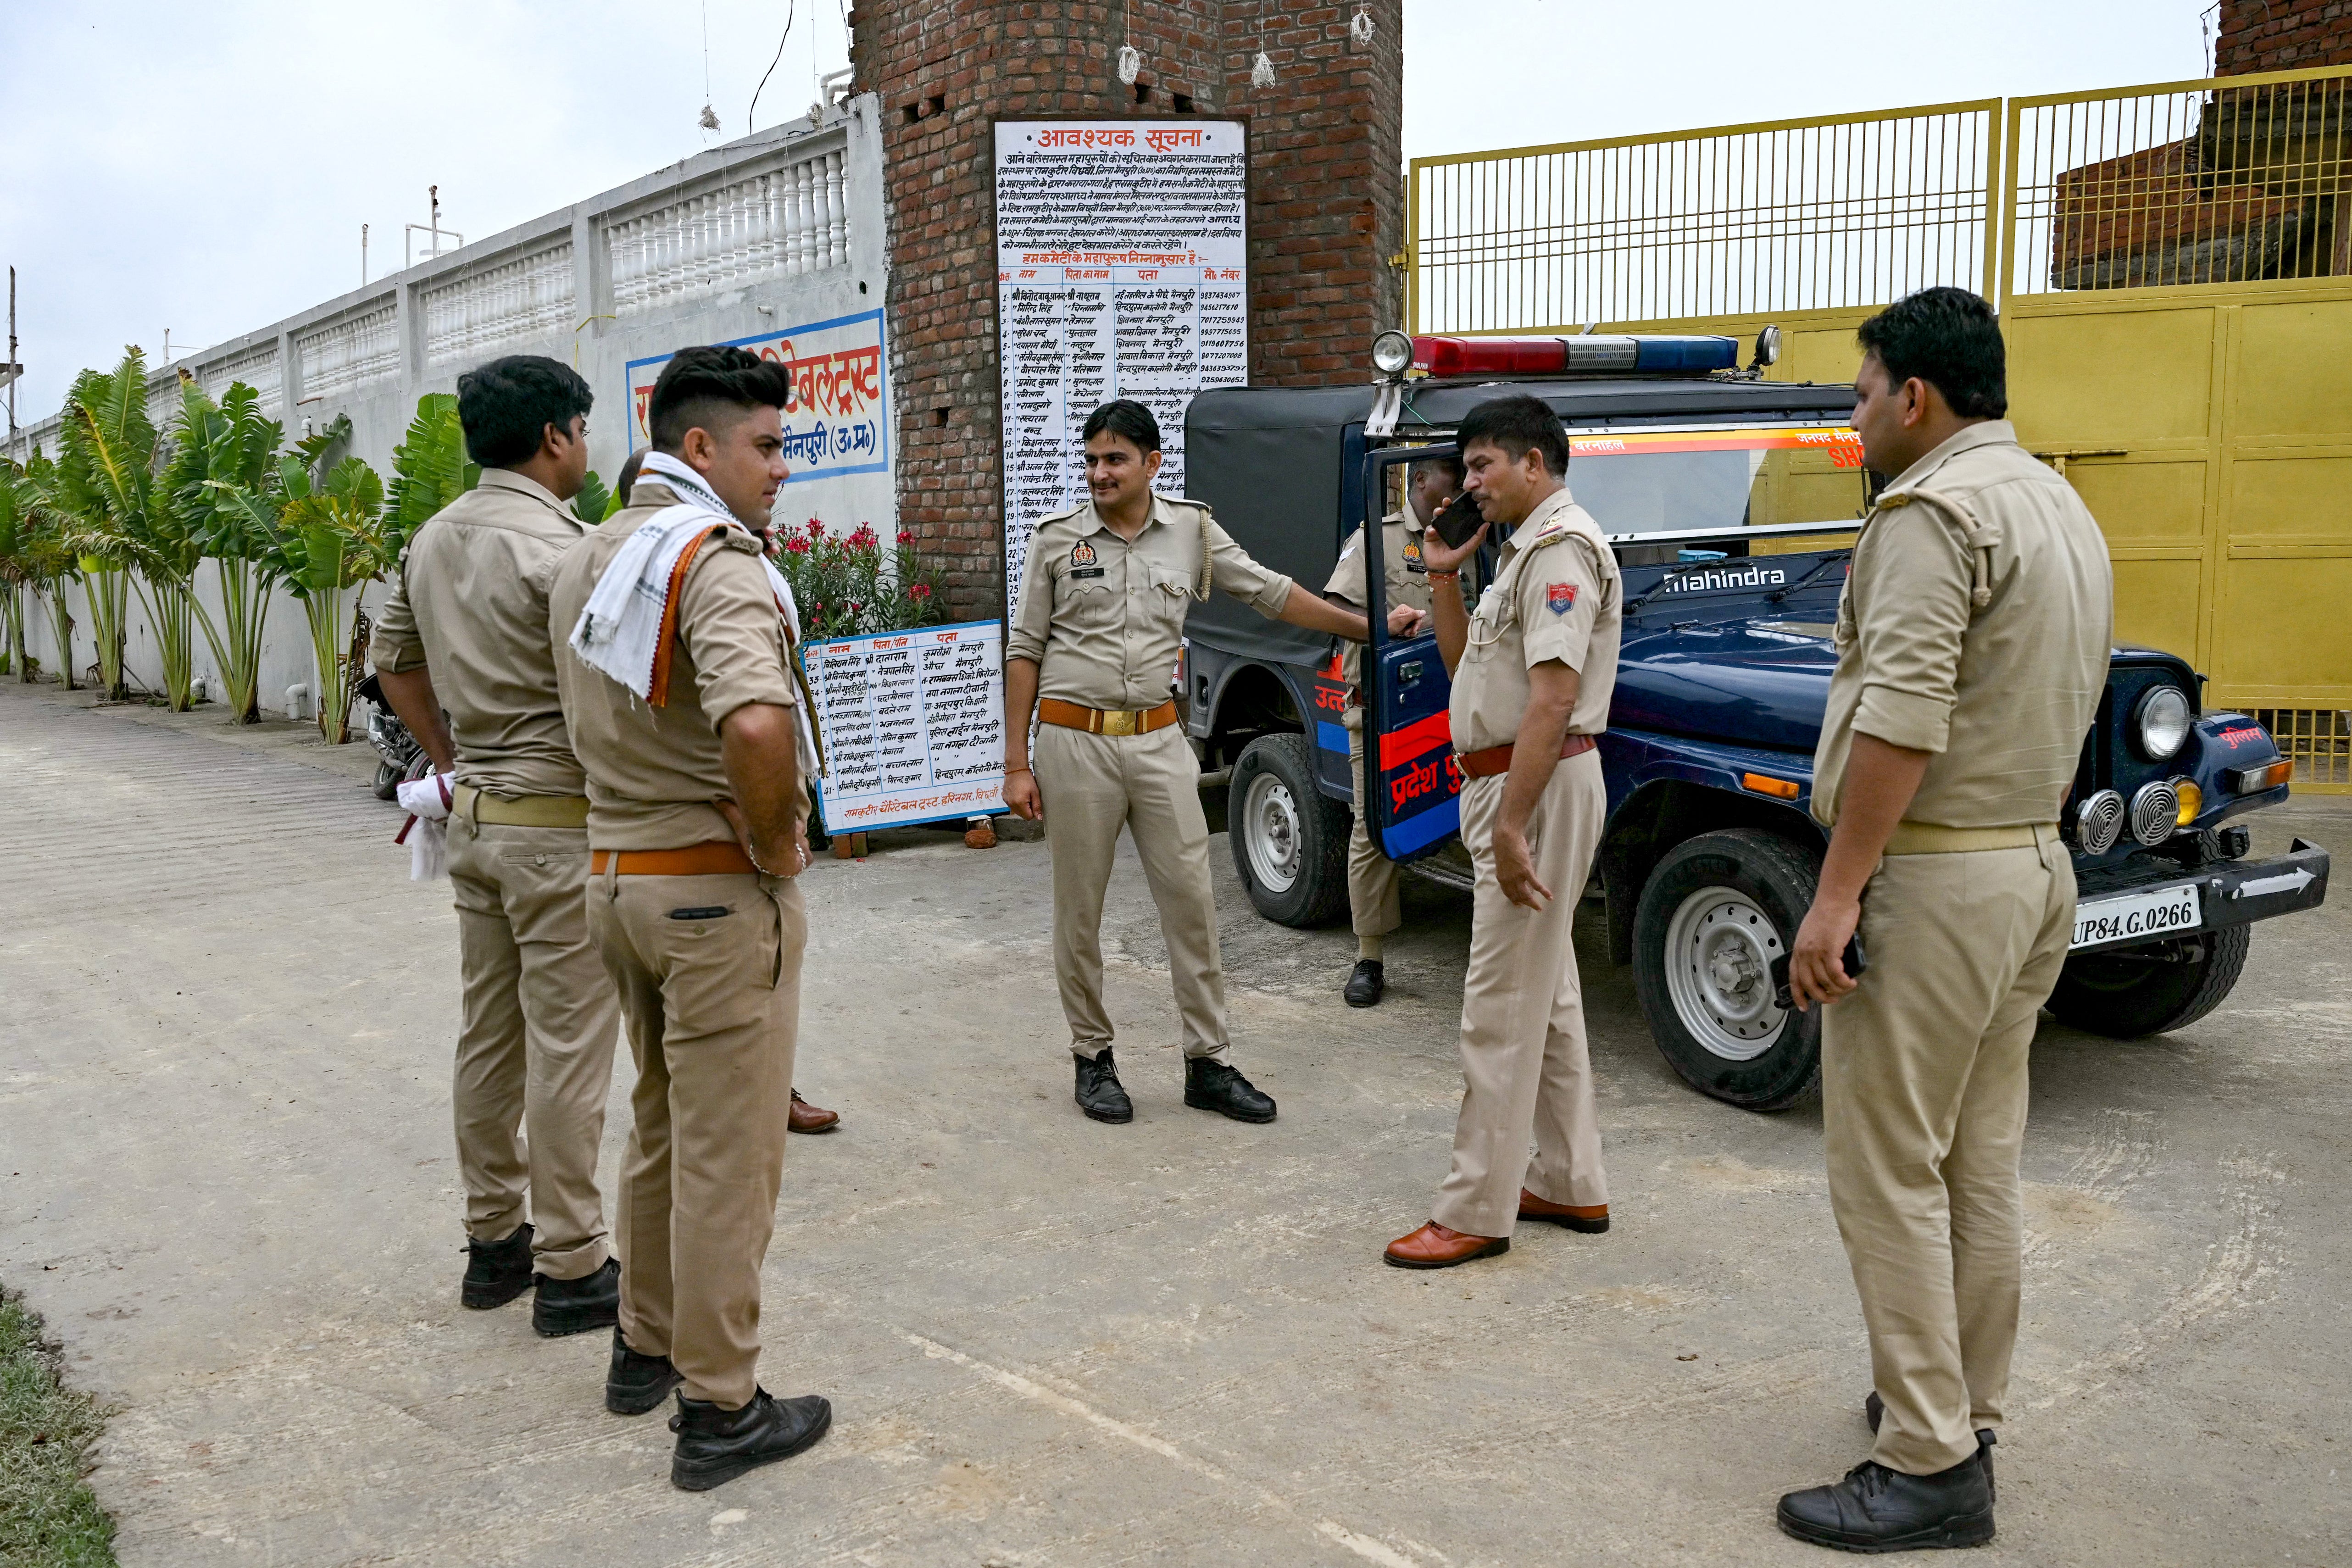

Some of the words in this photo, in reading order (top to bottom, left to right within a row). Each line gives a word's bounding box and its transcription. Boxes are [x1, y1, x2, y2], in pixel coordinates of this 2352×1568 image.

[1037, 129, 1135, 149] आवश्यक
[1145, 129, 1203, 152] सूचना
[1005, 151, 1025, 164] आने
[1026, 151, 1042, 164] वाले
[1042, 154, 1068, 164] समस्त
[1109, 151, 1122, 163] को
[1122, 152, 1146, 164] सूचित
[1146, 155, 1159, 164] कर
[1158, 155, 1186, 164] अवगत
[1185, 155, 1211, 164] कराया
[1211, 155, 1230, 164] जाता
[1230, 153, 1236, 165] है
[999, 217, 1010, 225] हम
[1010, 217, 1032, 225] समस्त
[1032, 214, 1053, 224] कमेटी
[1052, 214, 1060, 223] के
[1161, 214, 1169, 223] के
[1186, 214, 1206, 224] अपने
[1207, 216, 1241, 224] आराध्य
[1001, 240, 1013, 250] को
[1141, 239, 1163, 250] करते
[1023, 253, 1040, 264] हम
[1039, 250, 1072, 264] कमेटी
[1072, 250, 1083, 264] के
[1127, 250, 1186, 267] निम्नानुसार
[1187, 250, 1196, 266] है
[1018, 269, 1038, 278] नाम
[1065, 267, 1082, 280] पिता
[1083, 270, 1094, 279] का
[1094, 270, 1110, 279] नाम
[1137, 270, 1159, 281] पता
[1220, 267, 1241, 281] नंबर
[1012, 287, 1021, 301] श्री
[1076, 292, 1101, 302] नाथूराम
[1114, 289, 1126, 300] नई
[1124, 289, 1147, 300] तहसील
[1147, 289, 1154, 299] के
[1155, 288, 1170, 300] पीछे
[1171, 288, 1195, 300] मैनपुरी
[1039, 302, 1053, 314] सिंह
[1142, 301, 1168, 312] कालोनी
[1169, 301, 1193, 313] मैनपुरी
[1068, 314, 1096, 325] तेजराम
[1145, 314, 1175, 325] मैनपुरी
[1017, 328, 1033, 339] सुरेश
[1134, 326, 1158, 337] विकास
[1162, 325, 1192, 337] मैनपुरी
[1152, 337, 1184, 350] मैनपुरी
[1116, 352, 1140, 361] आवास
[1139, 349, 1166, 361] विकास
[1168, 349, 1194, 361] मैनपुरी
[1020, 363, 1048, 374] वीरपाल
[1047, 363, 1062, 374] सिंह
[1147, 363, 1173, 373] कालोनी
[1174, 362, 1198, 374] मैनपुरी
[1017, 376, 1038, 387] प्रमोद
[1038, 378, 1059, 389] कुमार
[1021, 398, 1052, 412] रामदुलारे
[782, 420, 828, 466] मैनपुरी
[1795, 433, 1832, 444] जनपद
[1573, 439, 1626, 452] बरनाहल
[1043, 461, 1060, 472] सिंह
[1042, 473, 1060, 484] सिंह
[1050, 484, 1066, 496] सिंह
[1042, 497, 1059, 508] सिंह
[828, 645, 851, 654] नाम
[937, 632, 959, 643] पता
[865, 654, 873, 665] श्री
[958, 641, 985, 654] मैनपुरी
[824, 671, 832, 682] श्री
[831, 670, 851, 680] विनोद
[849, 670, 867, 681] कुमार
[955, 655, 984, 670] मैनपुरी
[926, 689, 940, 698] नया
[940, 686, 964, 696] नगला
[929, 726, 948, 740] पुलिस
[971, 719, 1001, 733] मैनपुरी
[2219, 727, 2263, 749] पुलिस
[904, 773, 923, 784] कुमार
[1391, 761, 1439, 815] प्रदेश
